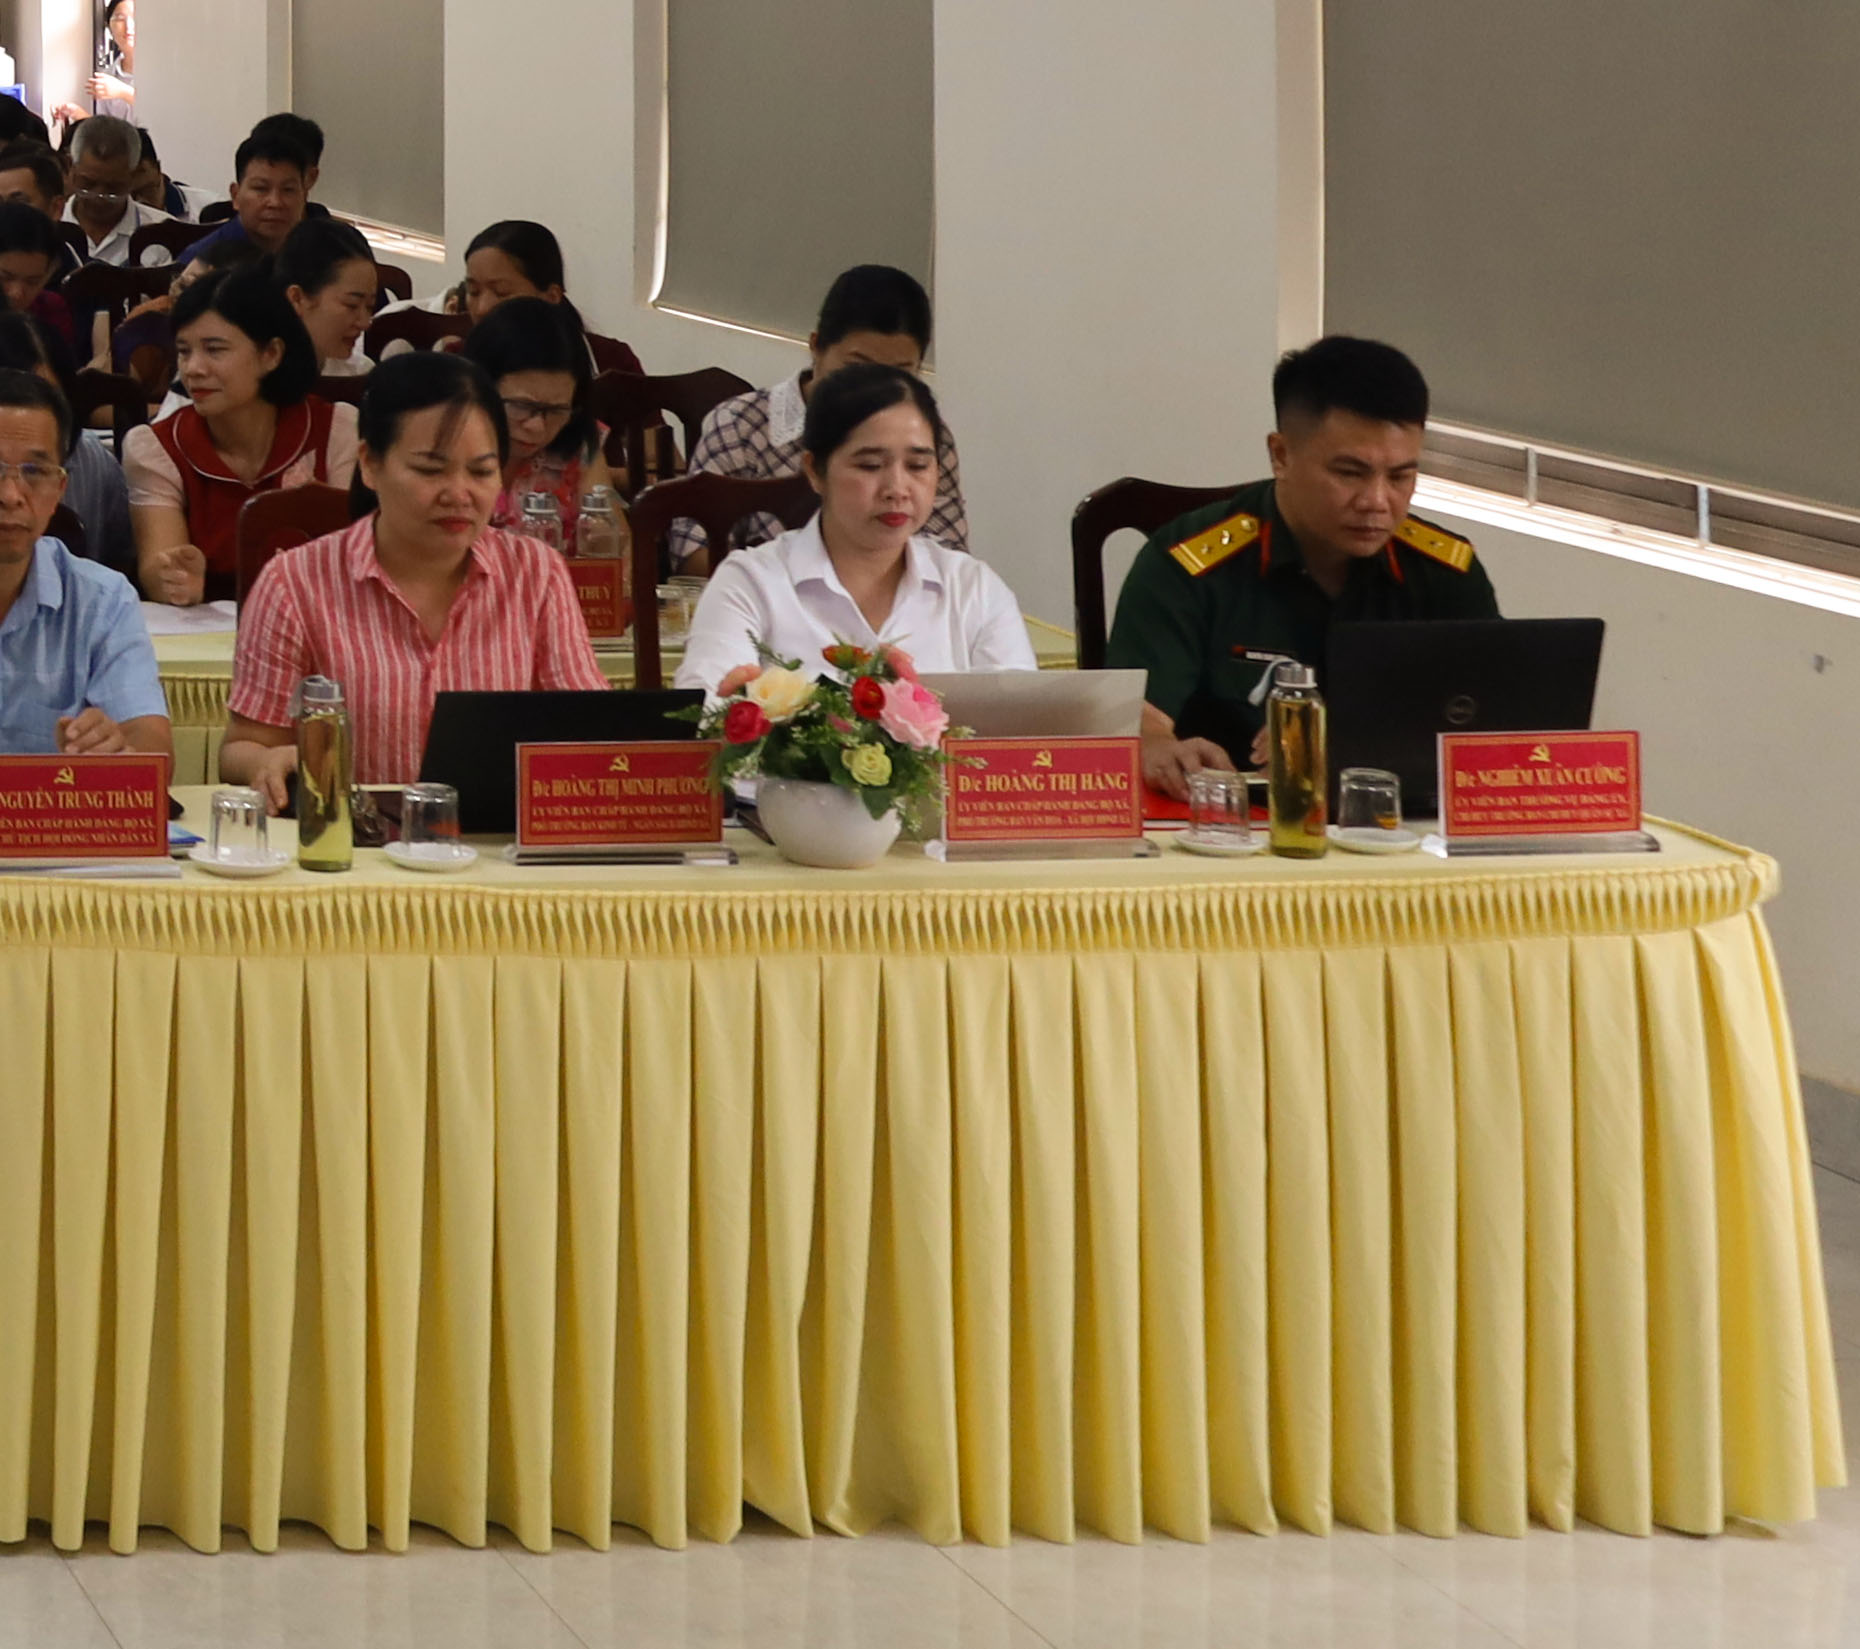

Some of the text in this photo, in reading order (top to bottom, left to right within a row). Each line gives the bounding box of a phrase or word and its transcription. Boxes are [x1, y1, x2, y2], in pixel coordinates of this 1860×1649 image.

[985, 770, 1045, 791] HOÀNG
[1048, 774, 1077, 794] THỊ
[58, 791, 103, 809] TRUNG
[107, 786, 154, 809] THÀNH
